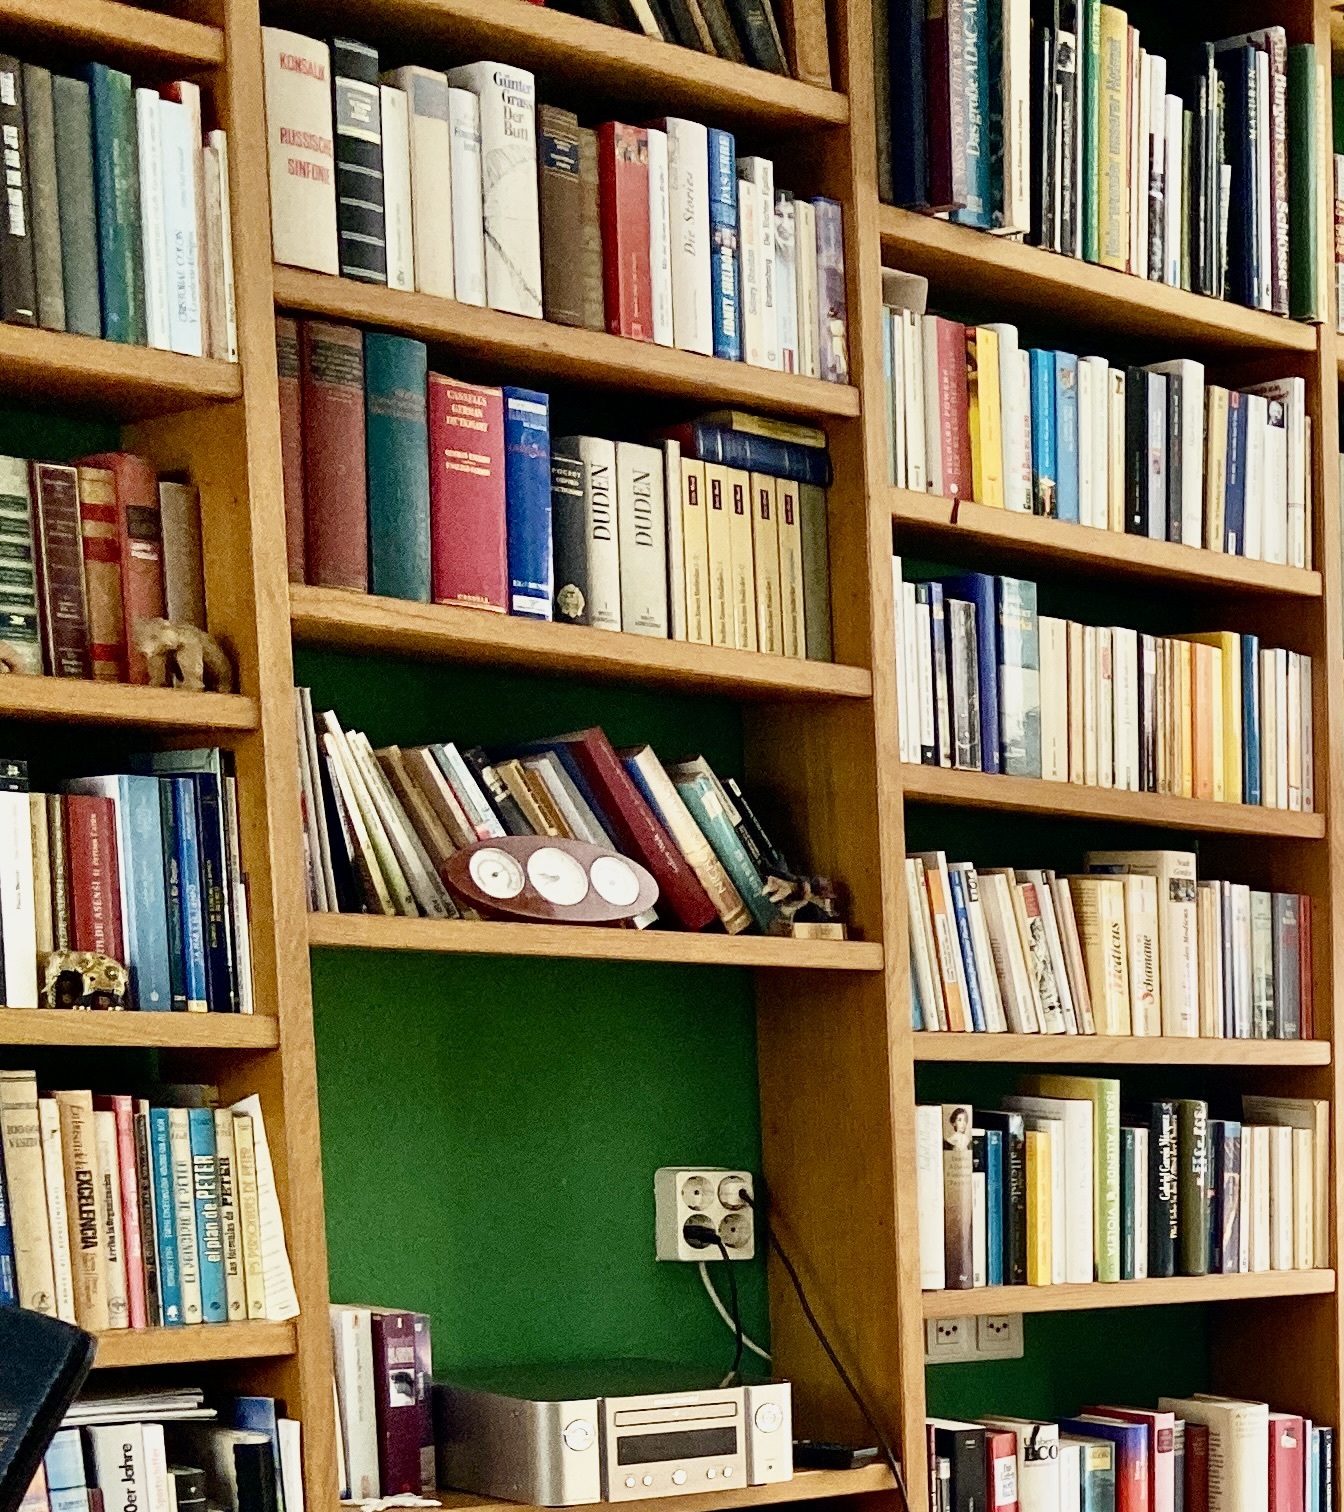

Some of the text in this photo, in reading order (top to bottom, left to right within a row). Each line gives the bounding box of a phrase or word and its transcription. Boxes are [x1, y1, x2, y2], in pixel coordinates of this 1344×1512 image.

[493, 72, 533, 95] Günter
[501, 92, 533, 110] Grass
[965, 79, 982, 125] große
[1274, 73, 1287, 141] Burgen
[503, 105, 524, 123] Der
[504, 121, 528, 141] Butt
[966, 126, 978, 156] Das
[683, 172, 696, 257] Die Stories
[1276, 200, 1289, 289] Schlösser
[591, 463, 611, 541] DUDEN
[633, 468, 653, 547] DUDEN
[1138, 934, 1155, 1005] Schamane
[218, 1157, 233, 1207] PETER
[1010, 1151, 1022, 1204] allende
[1106, 1090, 1118, 1257] ISABEL ALLENDE VIOLETA
[75, 1170, 99, 1250] EXCELENCIA
[193, 1155, 221, 1263] el plan de PETER
[226, 1261, 238, 1276] Las
[118, 1443, 135, 1485] Jahre
